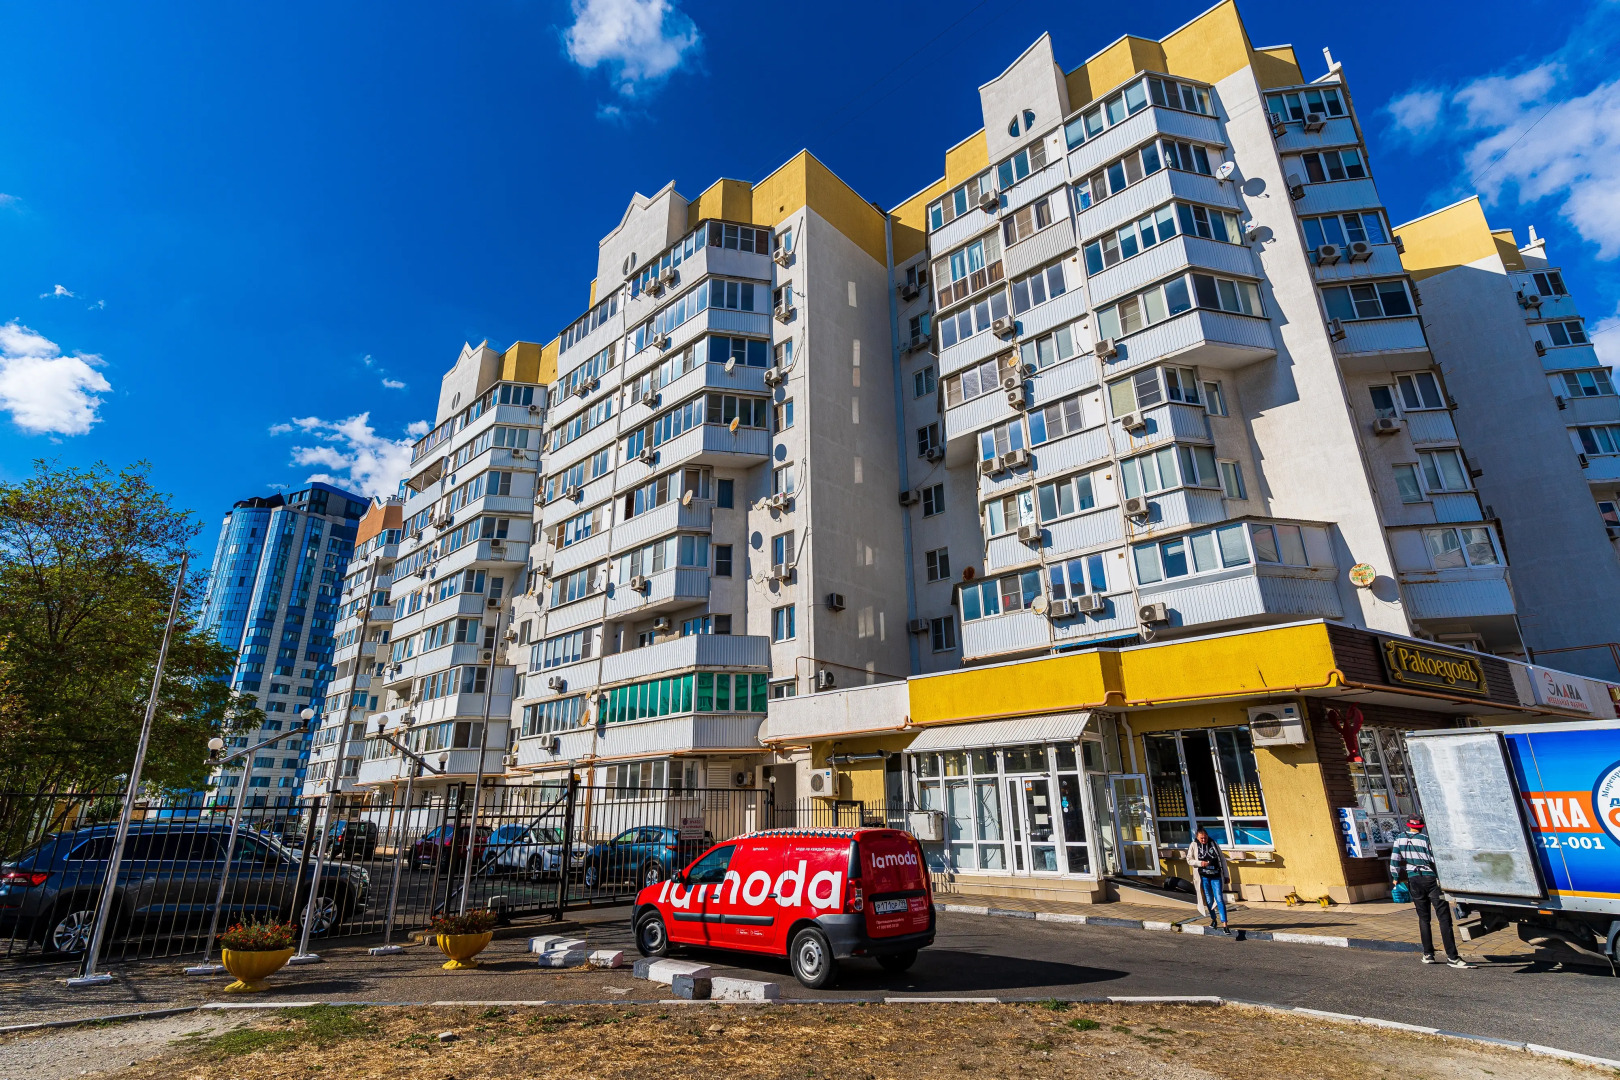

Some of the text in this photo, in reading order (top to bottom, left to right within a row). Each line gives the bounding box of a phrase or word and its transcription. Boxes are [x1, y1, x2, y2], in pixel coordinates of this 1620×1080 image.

[1337, 808, 1358, 858] ВОДА
[657, 859, 843, 910] lamoda
[871, 850, 918, 869] lamoda
